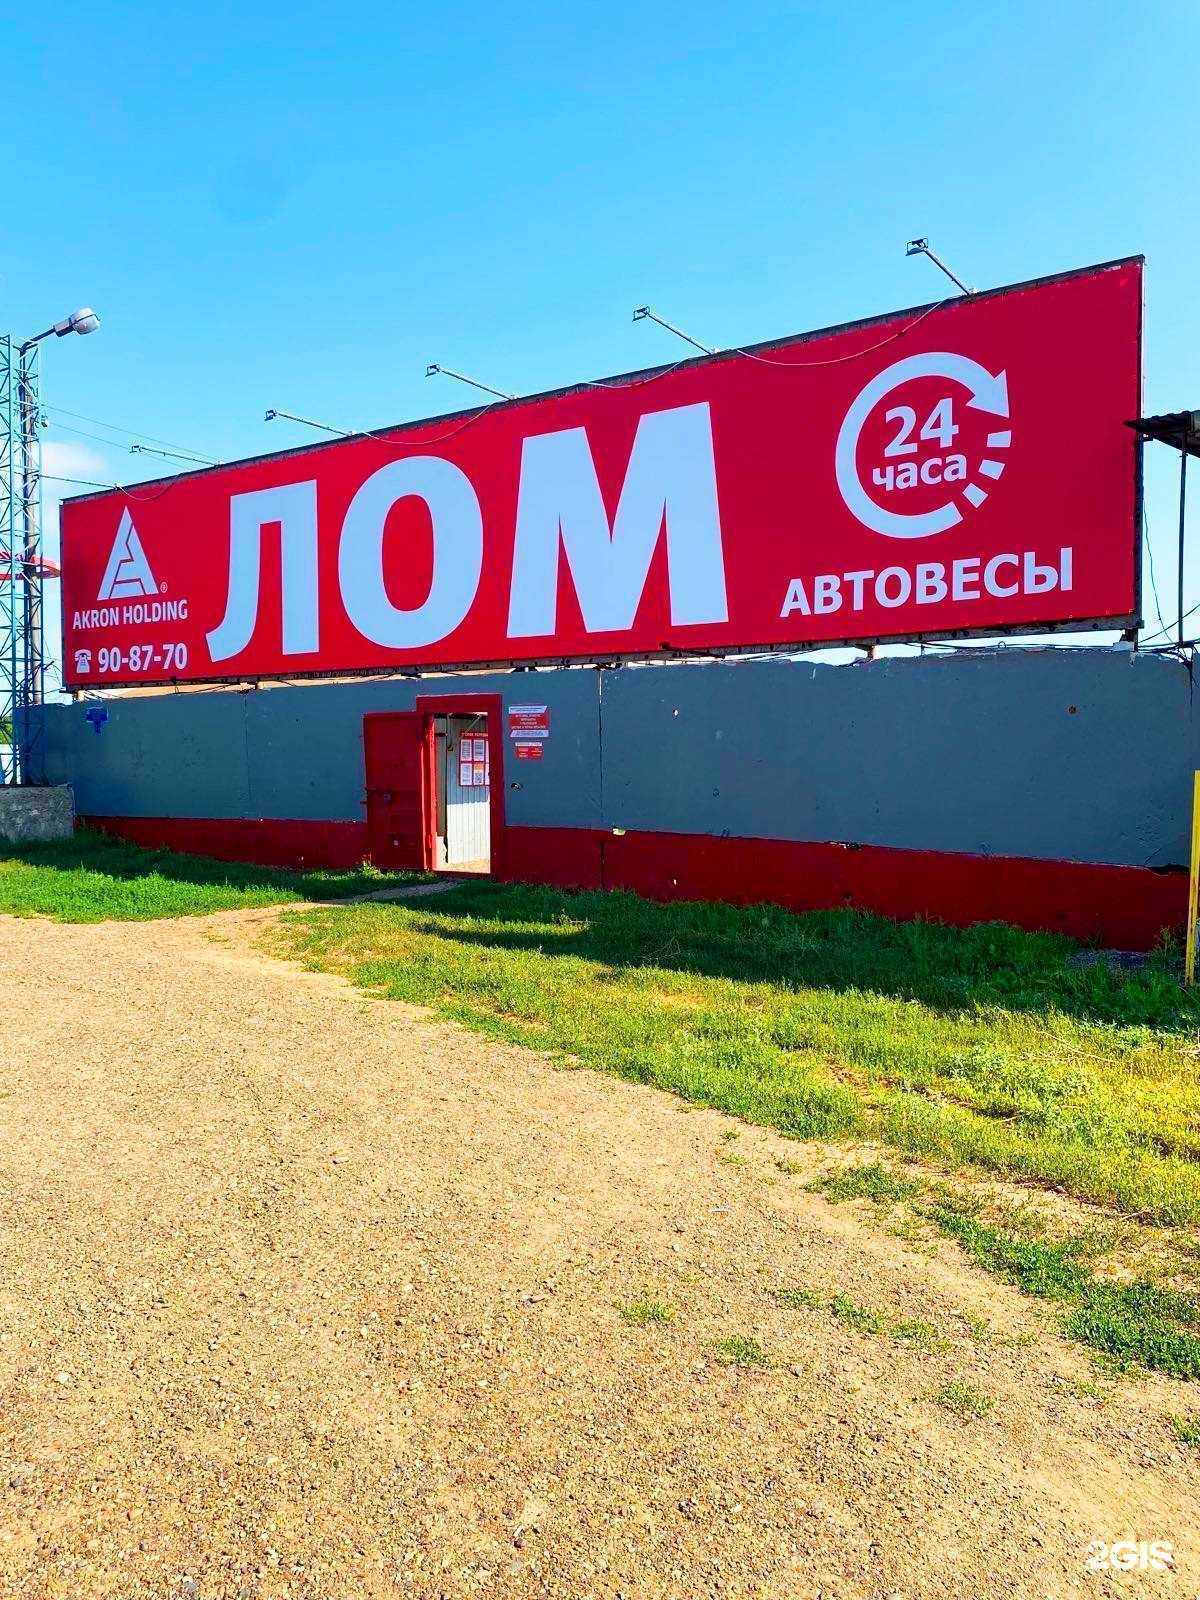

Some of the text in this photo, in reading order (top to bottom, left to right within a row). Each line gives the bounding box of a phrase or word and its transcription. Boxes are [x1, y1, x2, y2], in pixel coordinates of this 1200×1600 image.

[884, 397, 959, 458] 24
[872, 454, 967, 491] часа
[206, 401, 729, 662] ЛОМ
[780, 547, 1073, 618] АВТОВЕСЫ
[72, 600, 188, 629] AKRON HOLDING
[98, 643, 188, 673] 90-87-70
